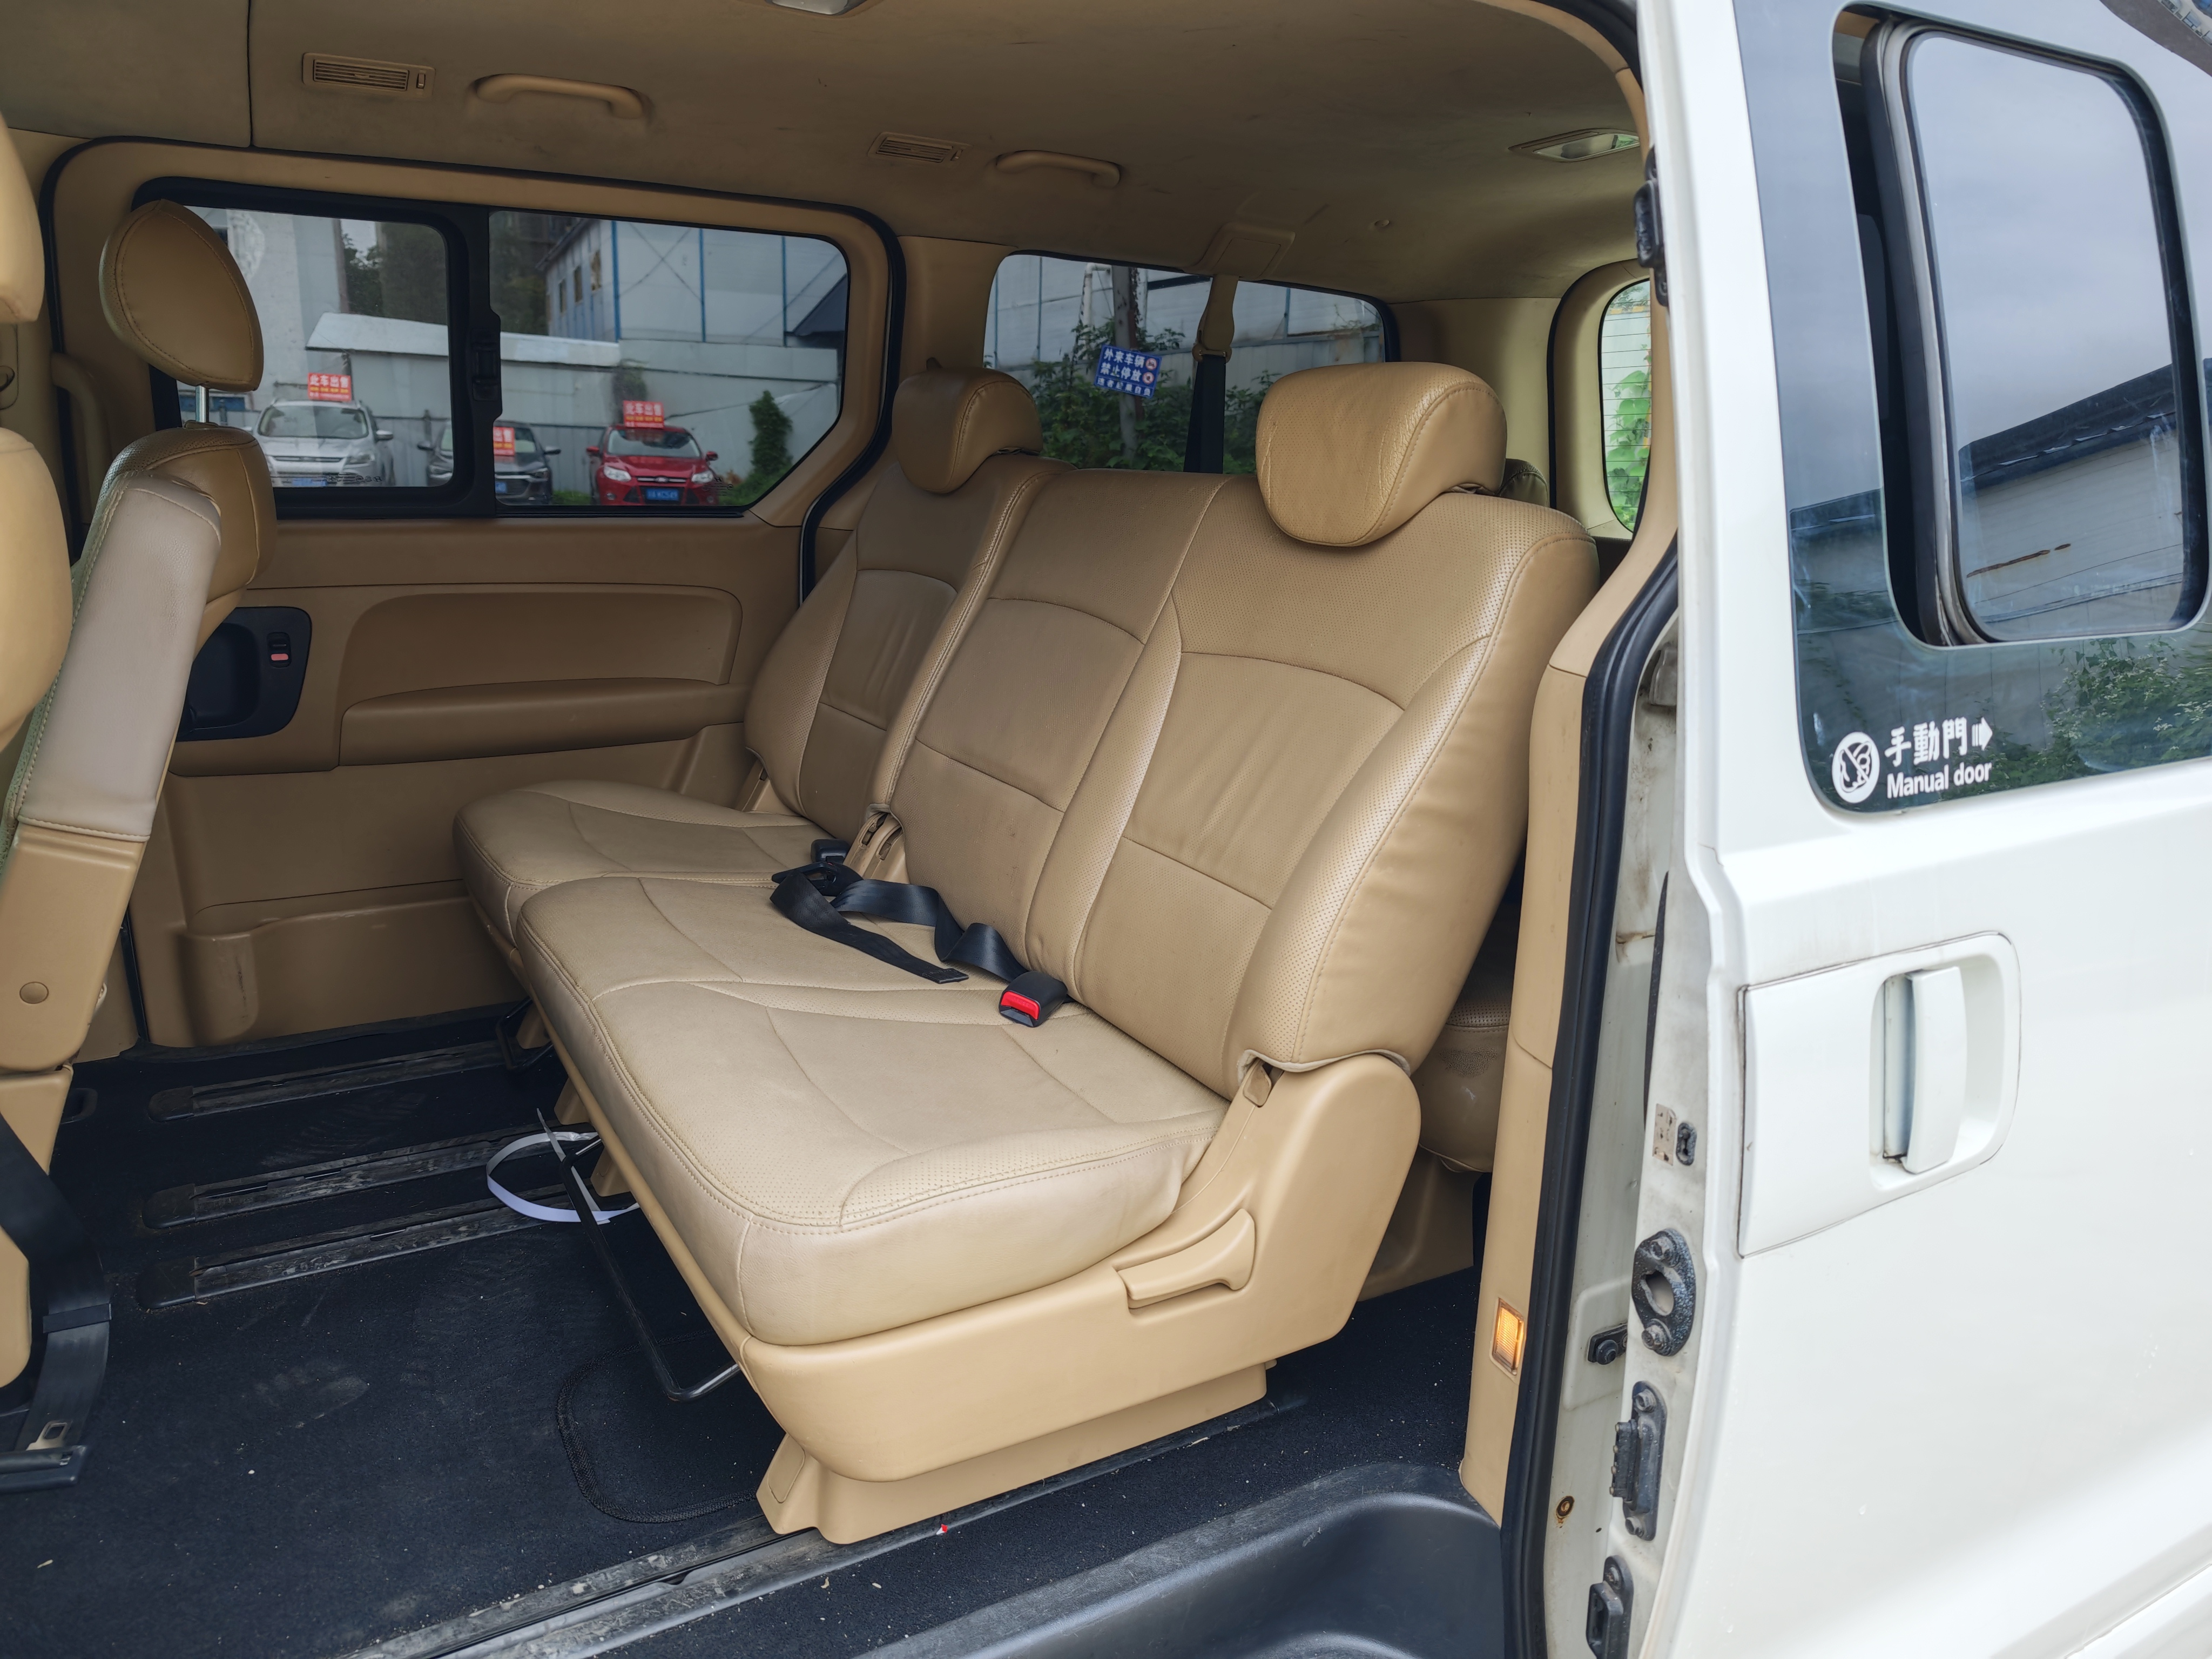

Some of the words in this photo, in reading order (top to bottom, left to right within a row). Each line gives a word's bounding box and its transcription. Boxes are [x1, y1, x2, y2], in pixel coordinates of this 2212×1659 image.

[1103, 348, 1145, 368] 外来车辆
[309, 374, 348, 388] 此车出售
[1100, 362, 1142, 382] 禁止停放
[1884, 717, 1967, 767] 手動門
[1887, 764, 1949, 799] Manual
[1953, 761, 1993, 786] door
